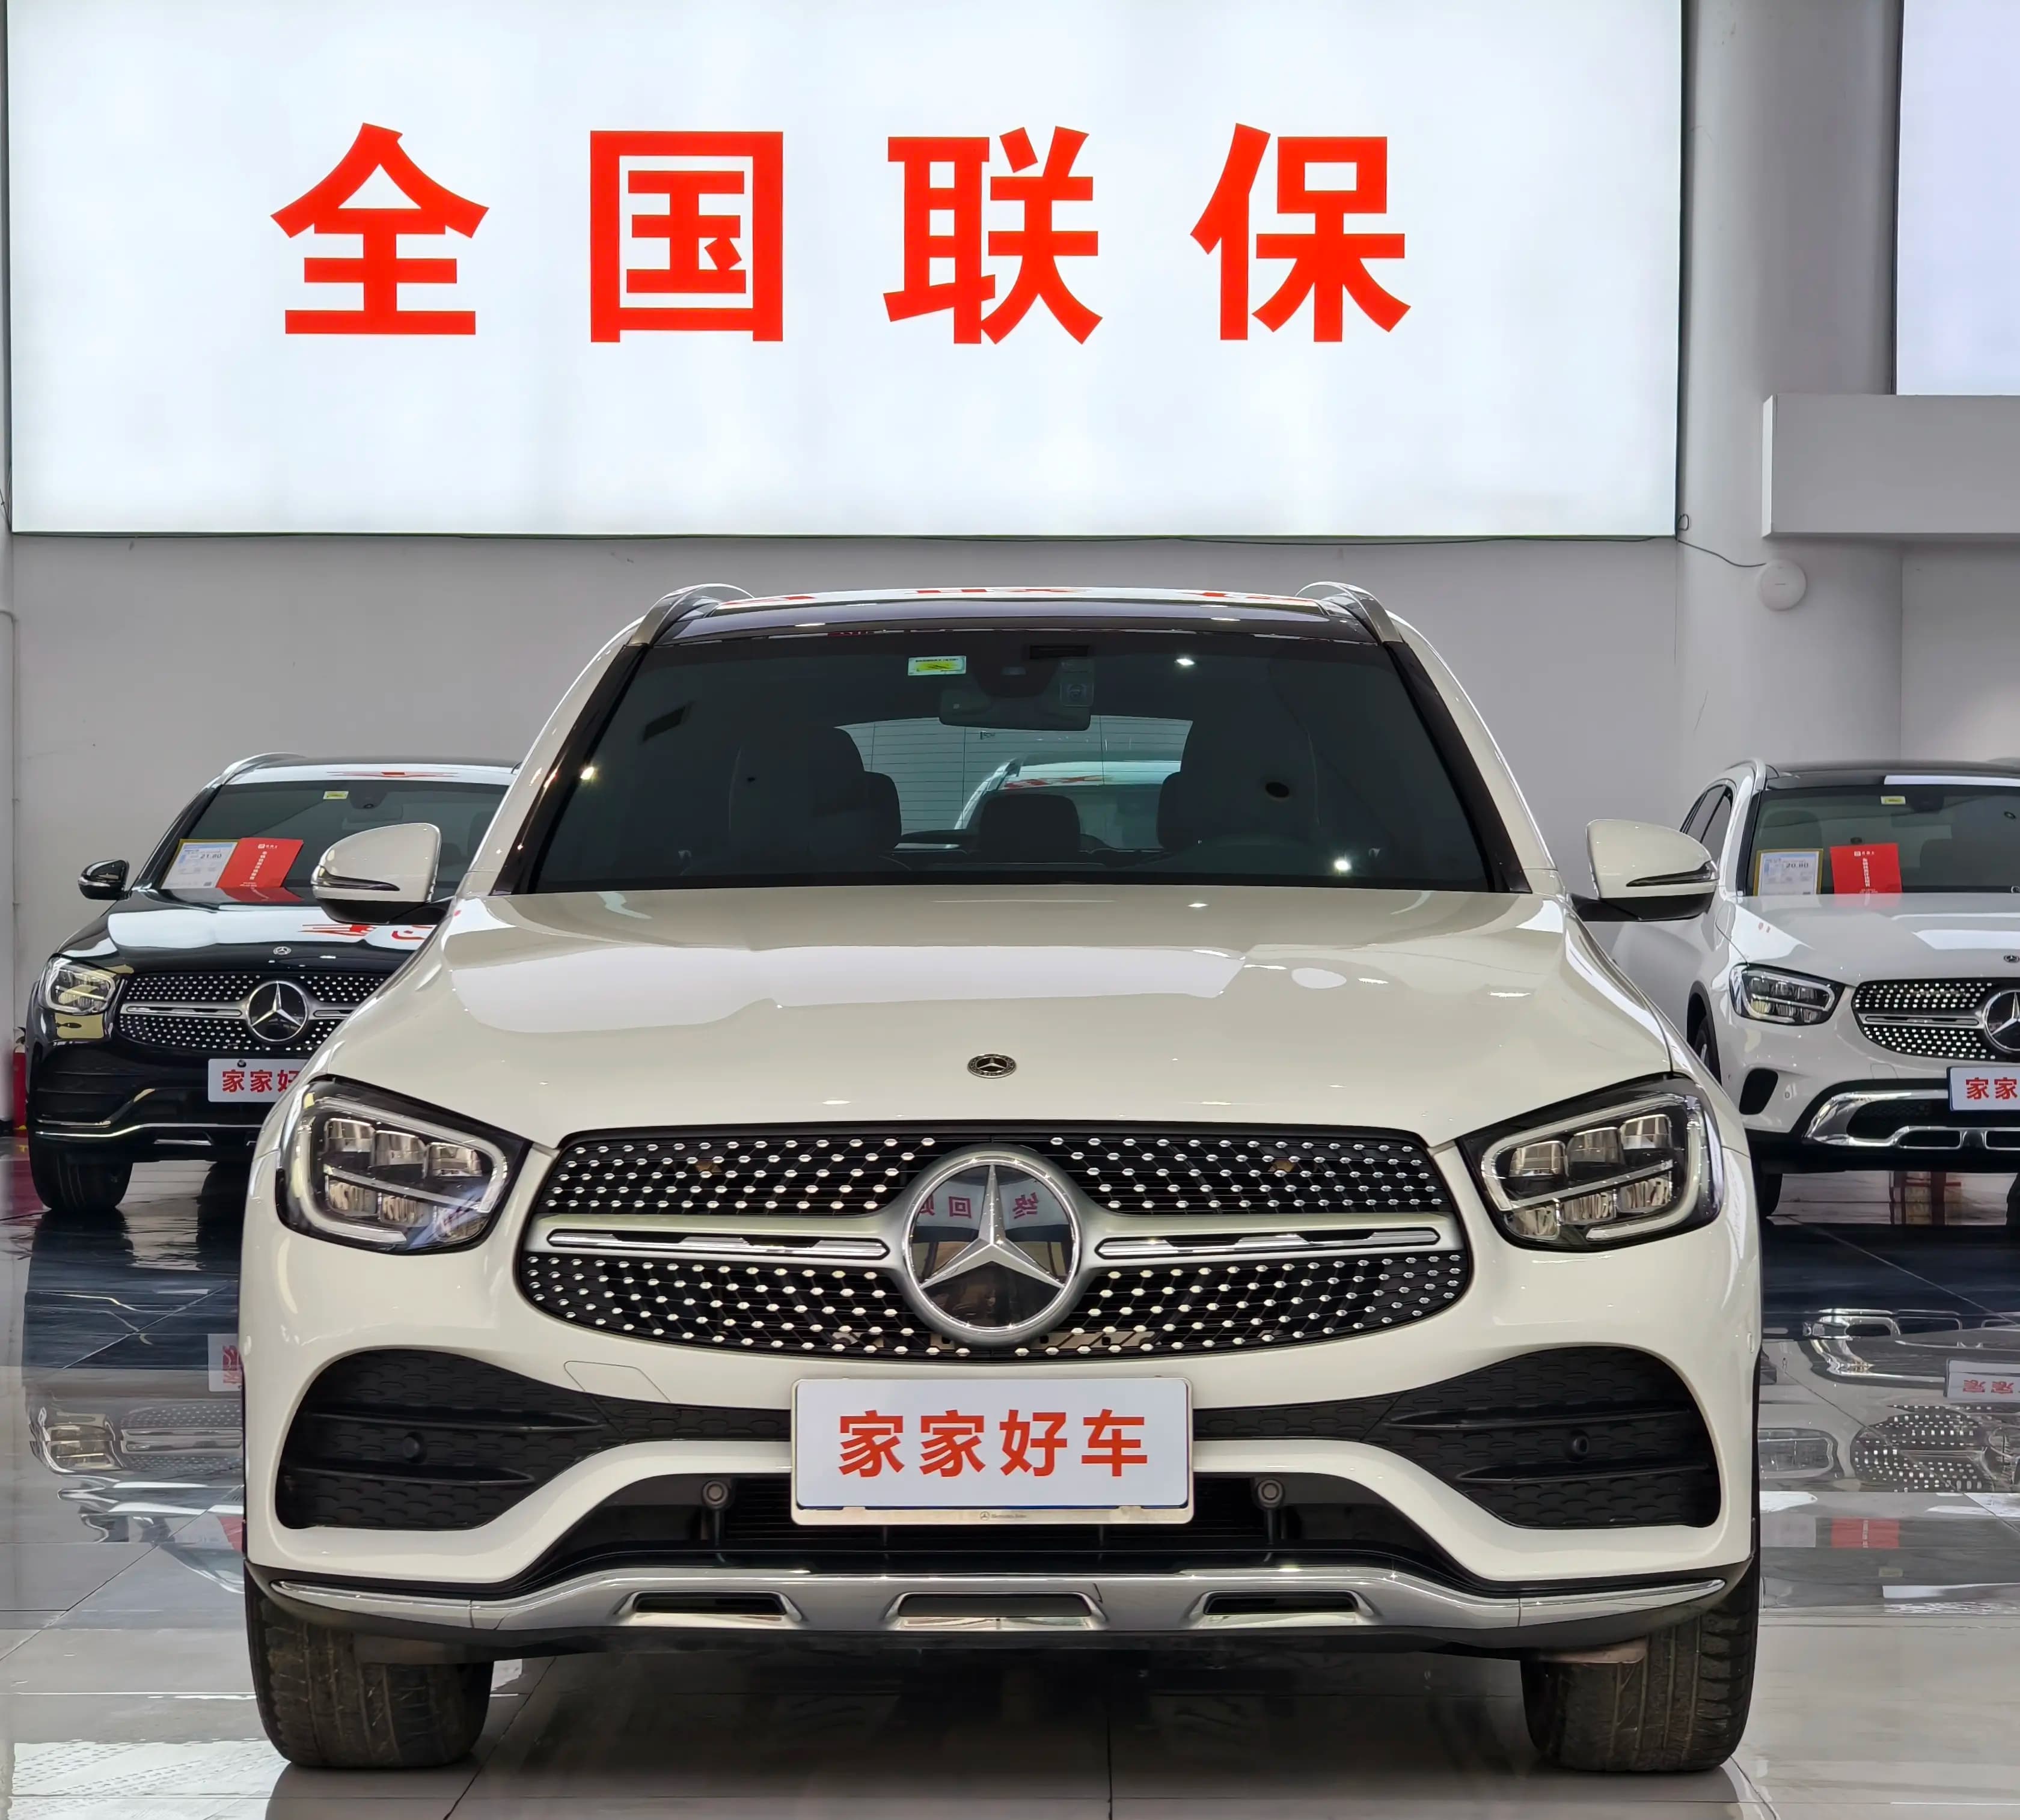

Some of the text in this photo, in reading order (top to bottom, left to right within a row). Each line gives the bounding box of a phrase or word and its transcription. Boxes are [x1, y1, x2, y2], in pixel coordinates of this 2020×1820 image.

[271, 122, 1412, 346] 全国联保
[1965, 1076, 2018, 1101] 家家
[838, 1408, 1149, 1479] 家家好车
